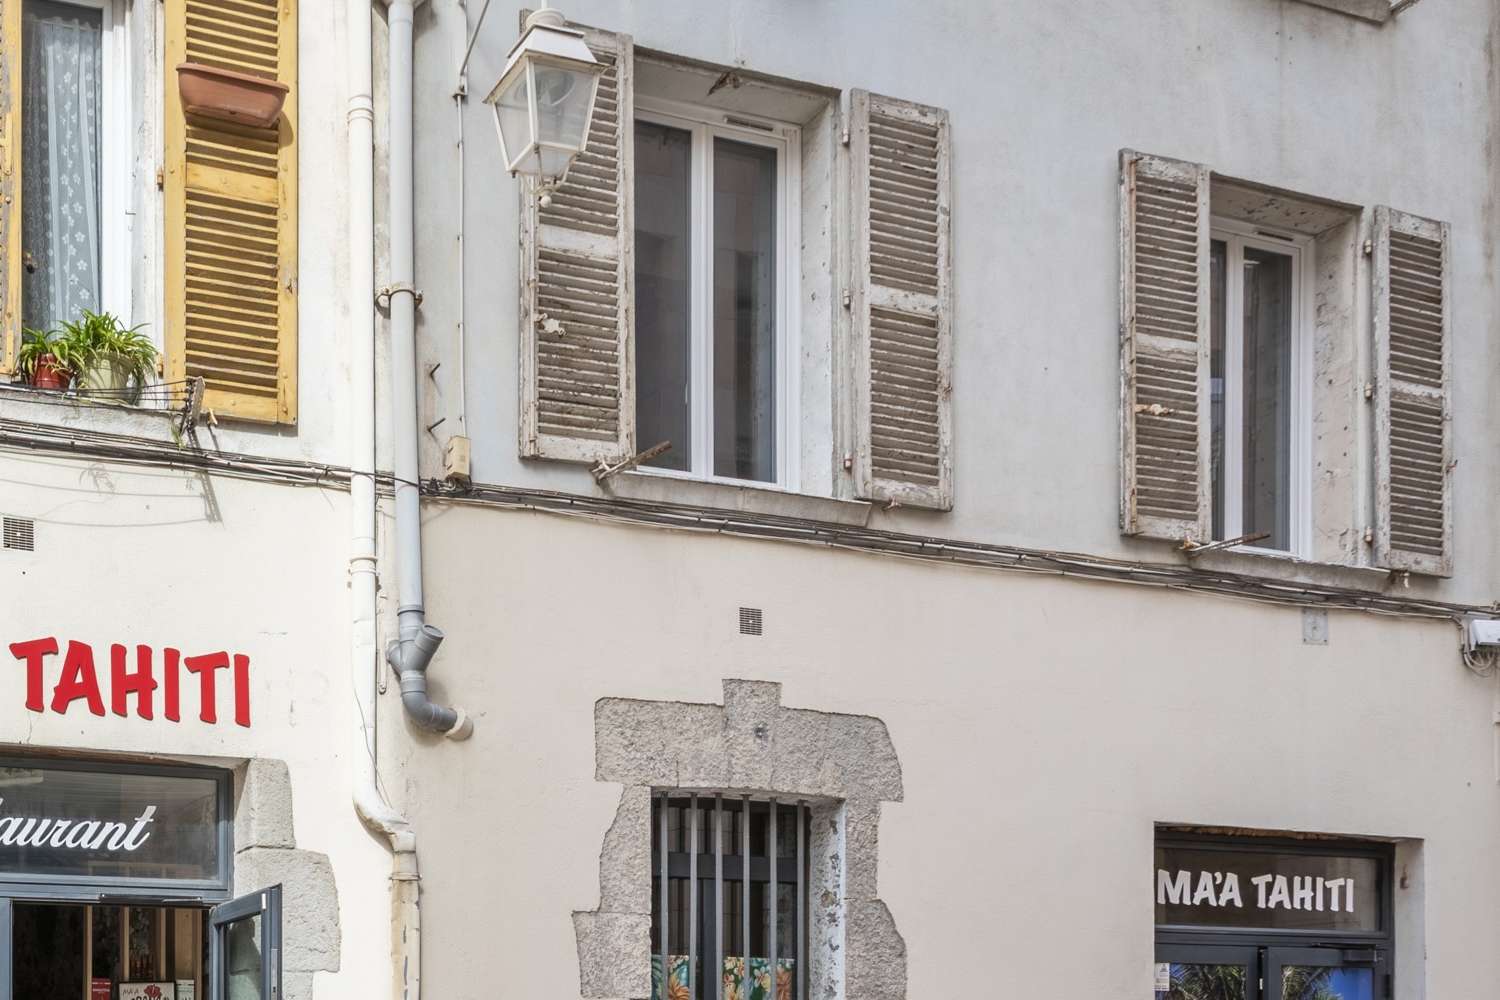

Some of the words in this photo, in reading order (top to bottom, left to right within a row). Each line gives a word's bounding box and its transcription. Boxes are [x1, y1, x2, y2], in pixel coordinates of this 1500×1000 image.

[9, 636, 251, 728] TAHITI
[1157, 869, 1243, 908] MA'A
[1251, 873, 1355, 913] TAHITI
[122, 988, 140, 996] MA'A
